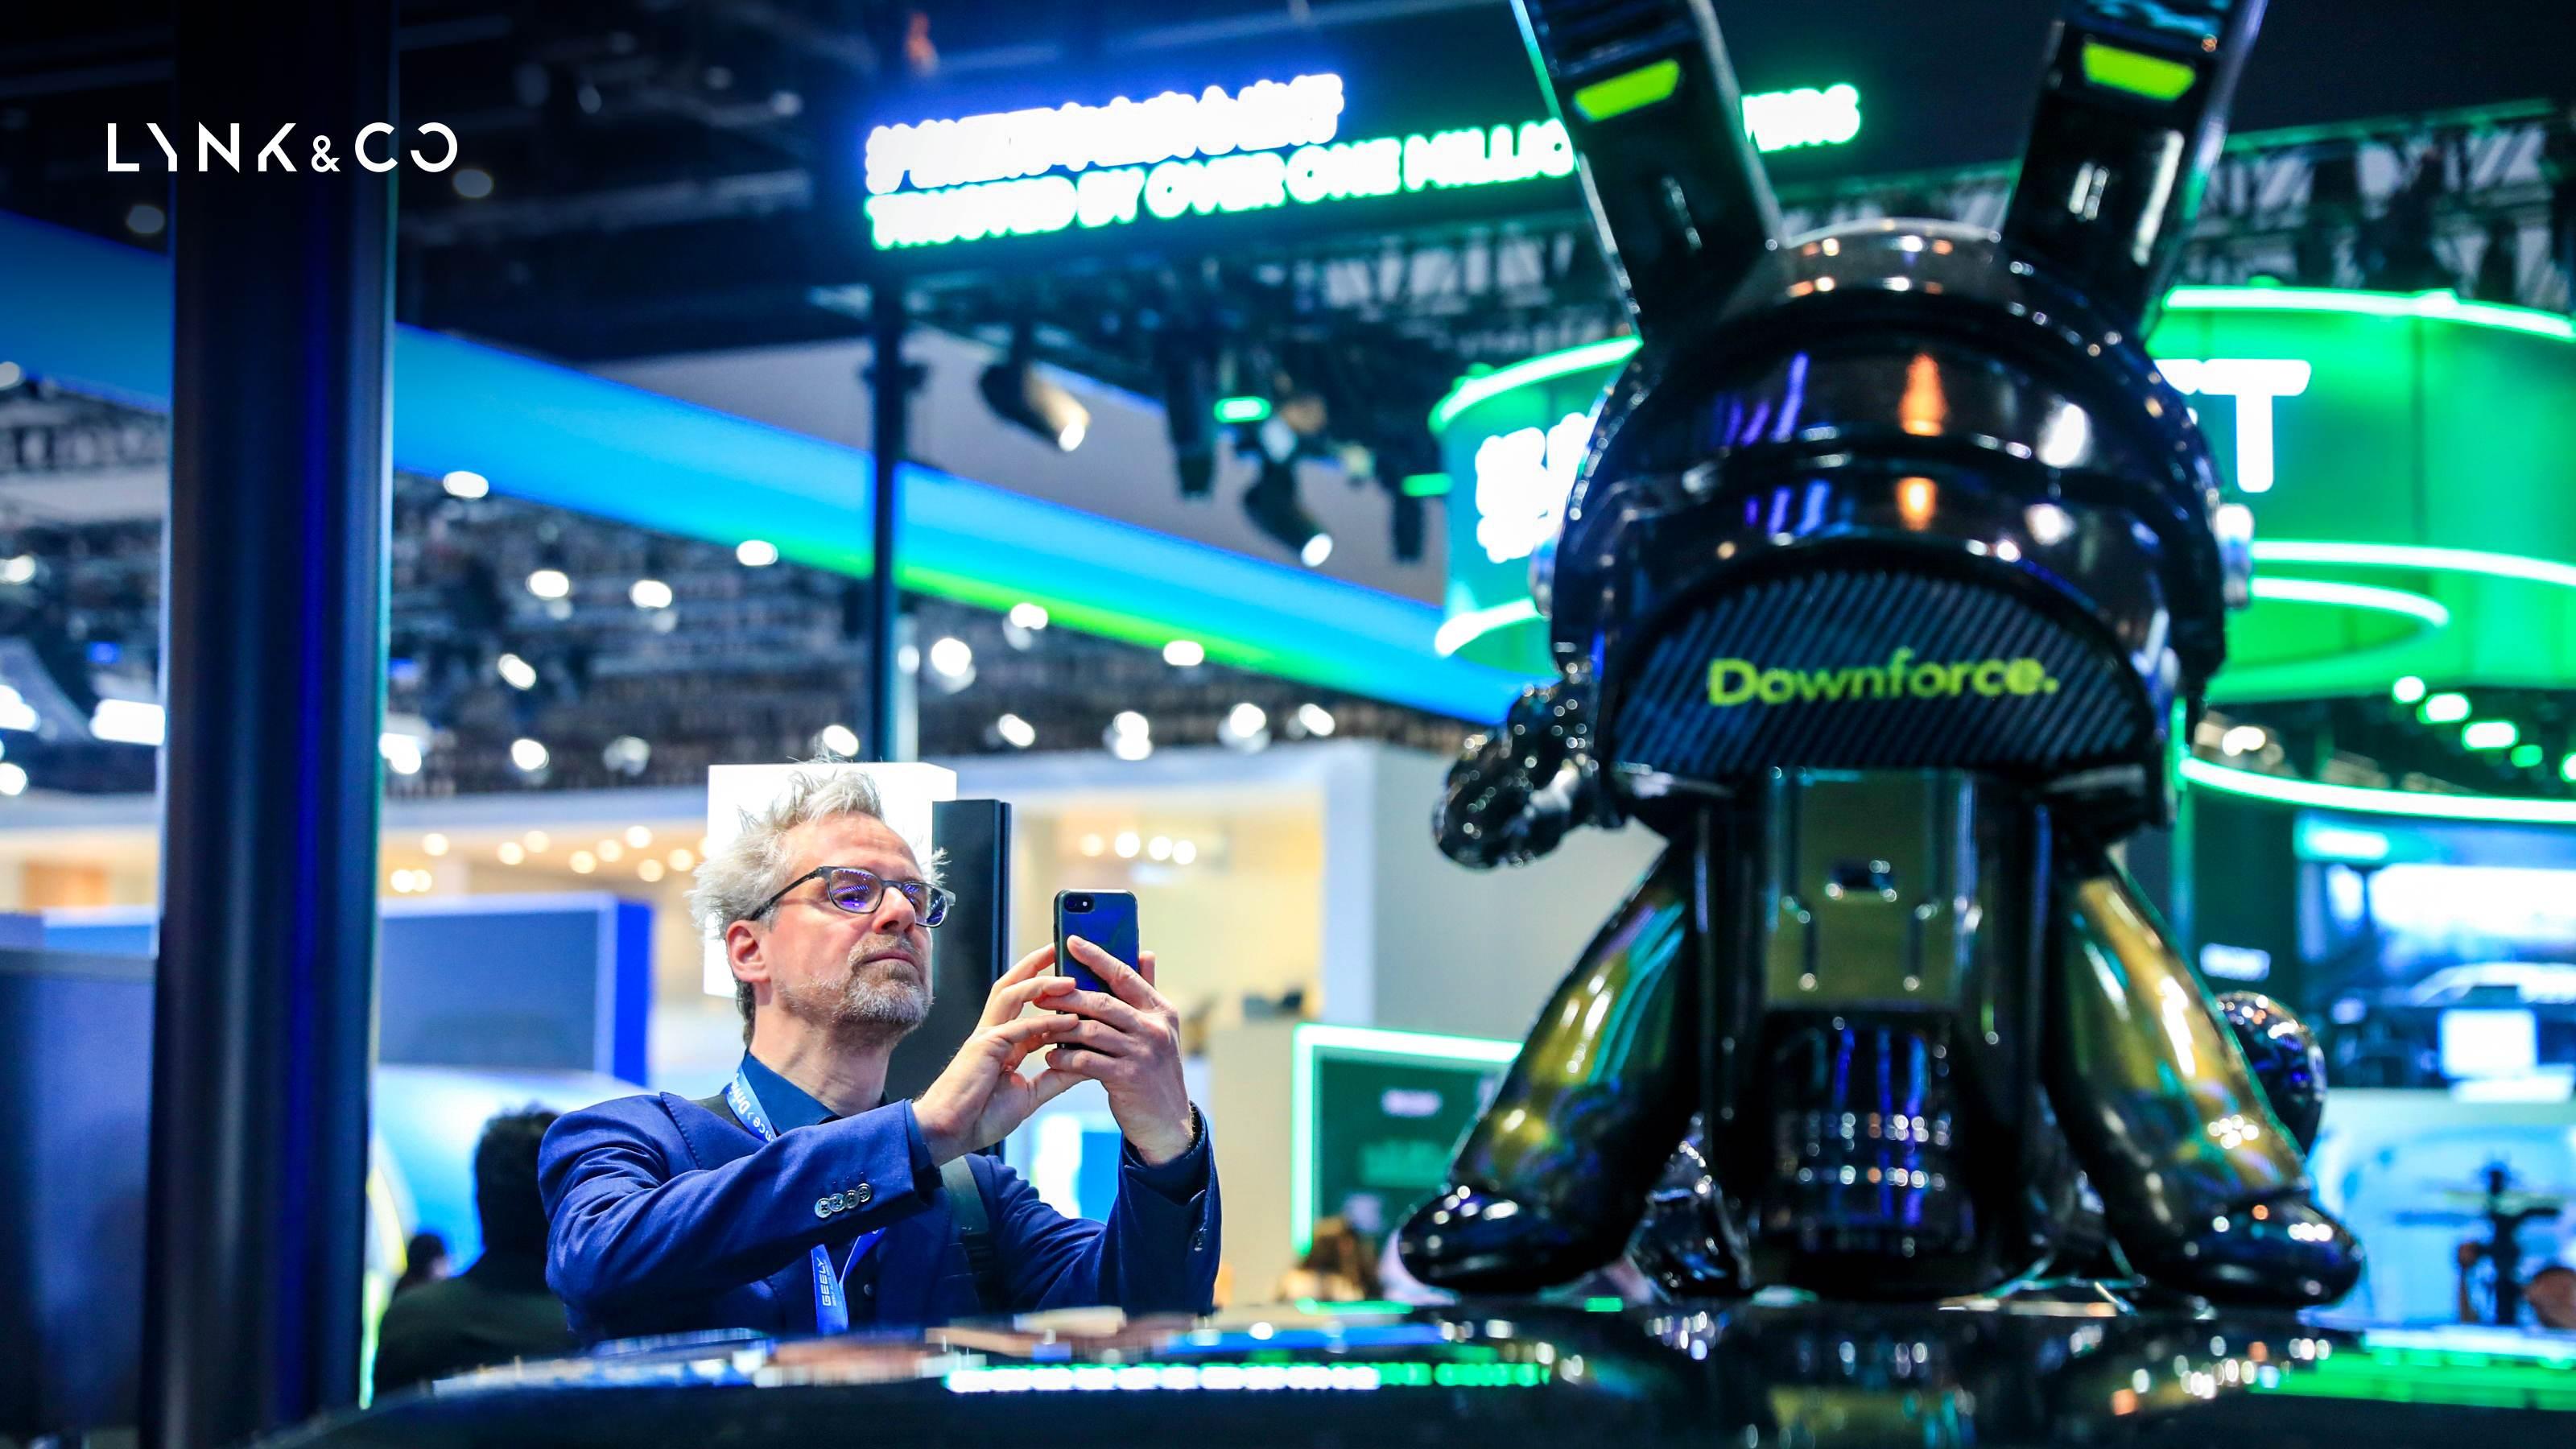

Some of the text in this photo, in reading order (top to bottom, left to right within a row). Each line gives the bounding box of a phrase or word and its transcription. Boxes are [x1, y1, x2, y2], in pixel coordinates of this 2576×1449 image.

[1077, 167, 1146, 228] BY
[1145, 152, 1287, 219] OVER
[1286, 136, 1402, 204] ONE
[1403, 118, 1576, 192] MILLIO
[1707, 646, 2059, 706] Downforce.
[816, 1257, 832, 1307] GEELY
